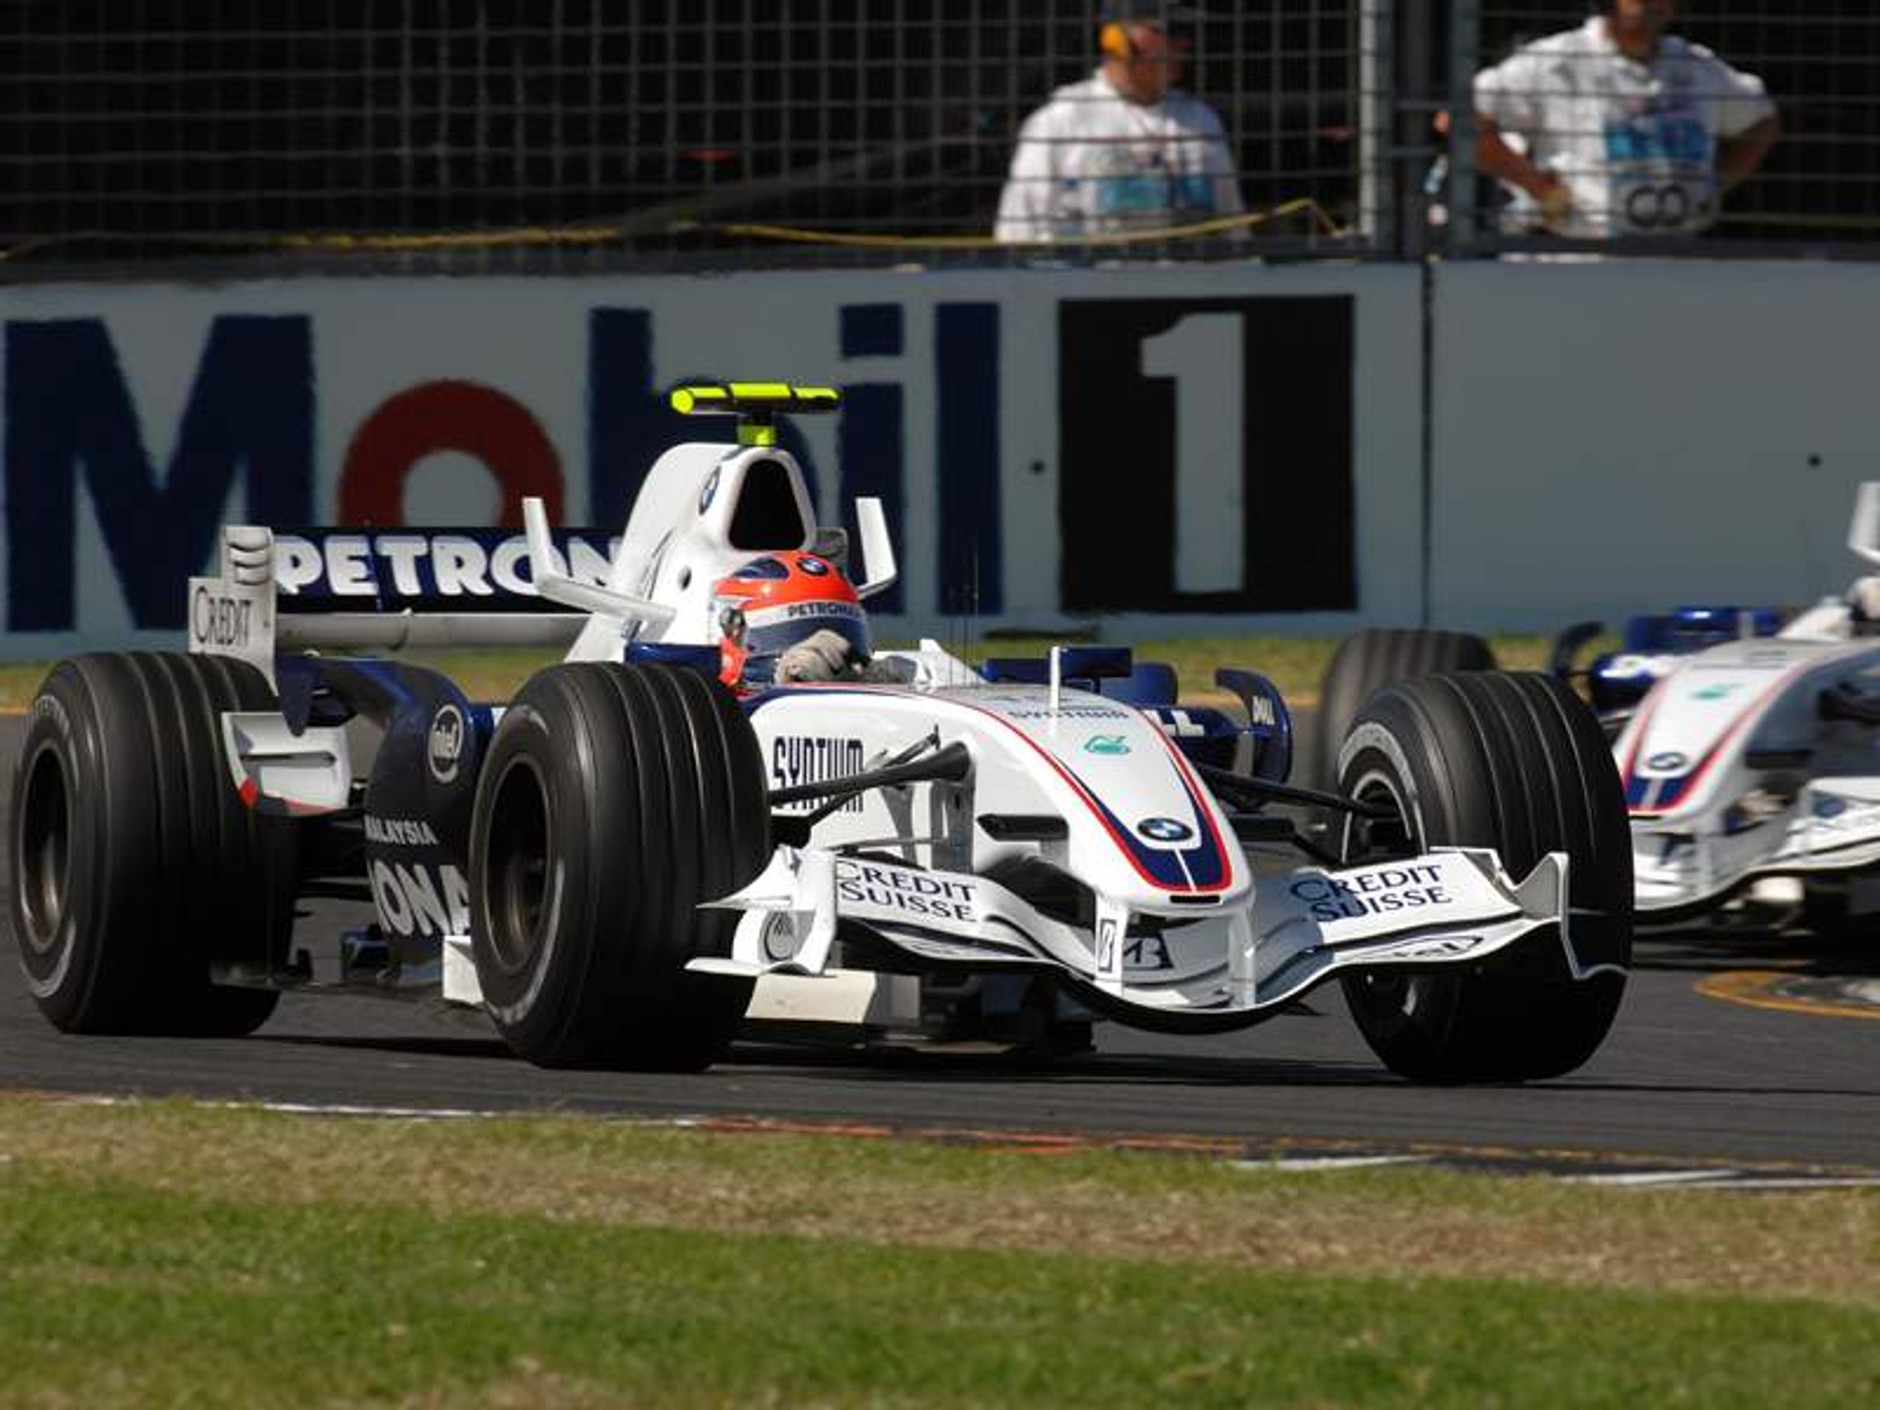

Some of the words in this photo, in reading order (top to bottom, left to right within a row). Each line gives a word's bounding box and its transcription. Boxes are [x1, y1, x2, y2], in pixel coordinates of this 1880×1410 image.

[1140, 312, 1244, 592] 1
[193, 585, 251, 647] CREDIT
[836, 860, 977, 902] CREDIT
[839, 880, 978, 922] SUISSE
[1289, 864, 1442, 902] CREDIT
[1308, 886, 1454, 923] SUISSE
